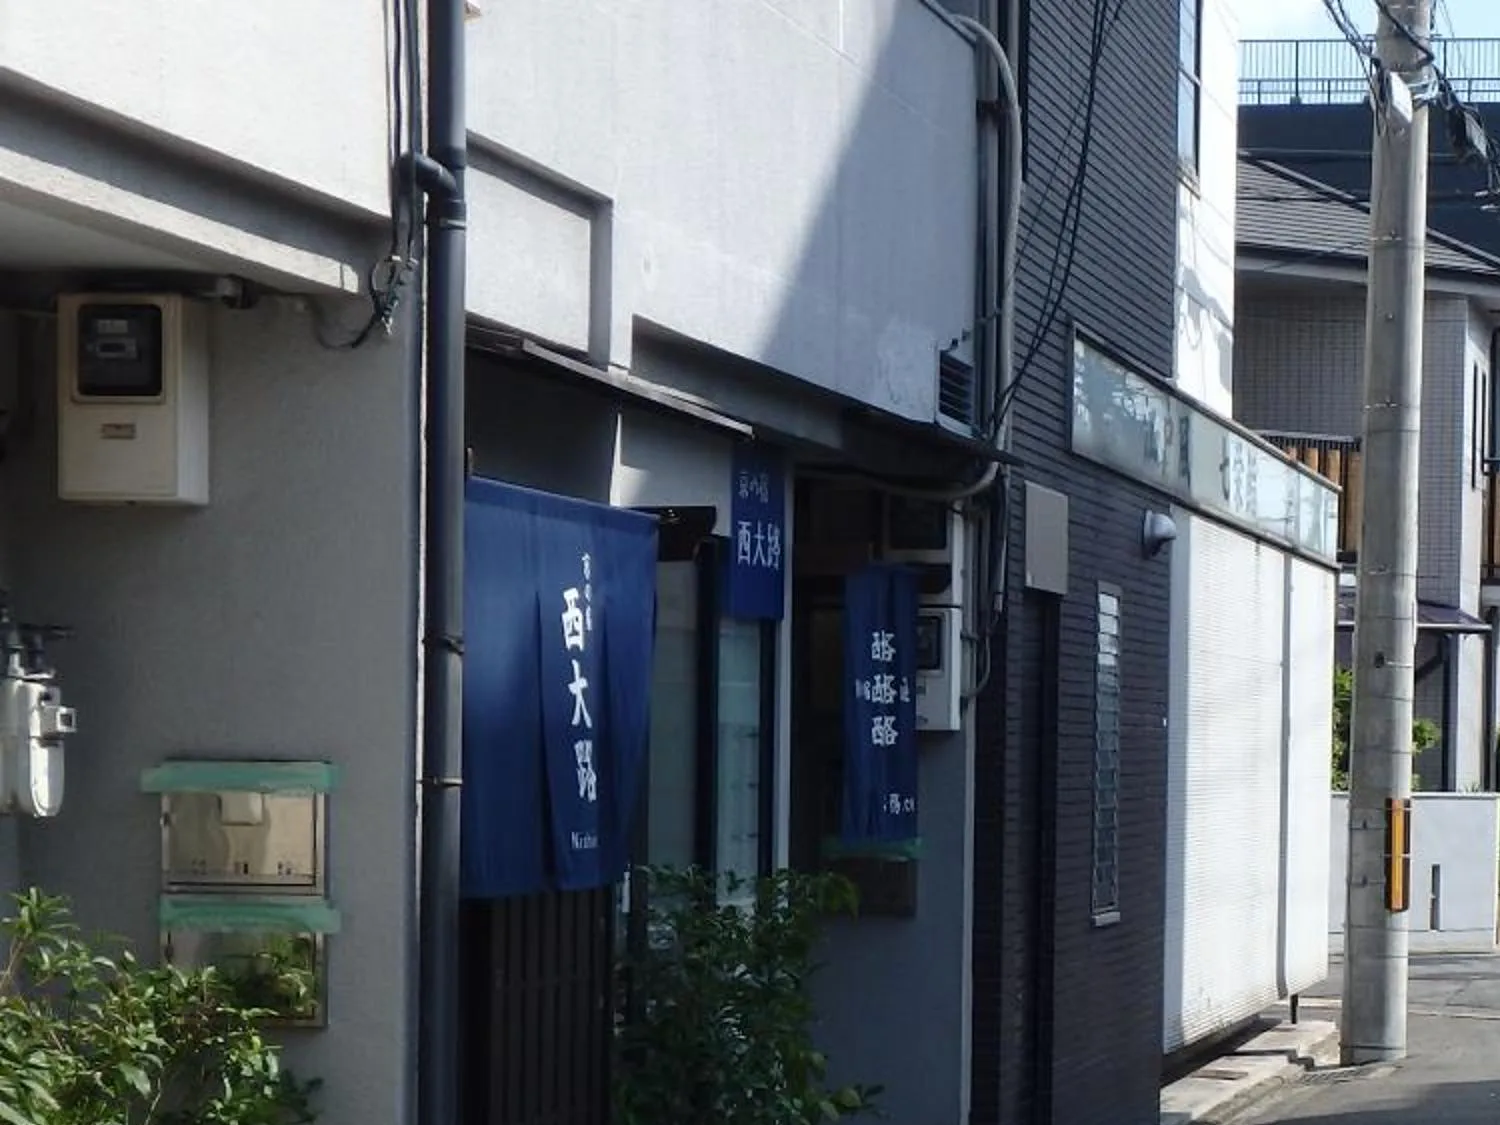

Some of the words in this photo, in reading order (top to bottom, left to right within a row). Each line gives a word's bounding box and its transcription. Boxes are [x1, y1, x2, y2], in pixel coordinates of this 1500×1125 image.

[737, 519, 781, 570] 西大路
[561, 587, 597, 802] 西大路
